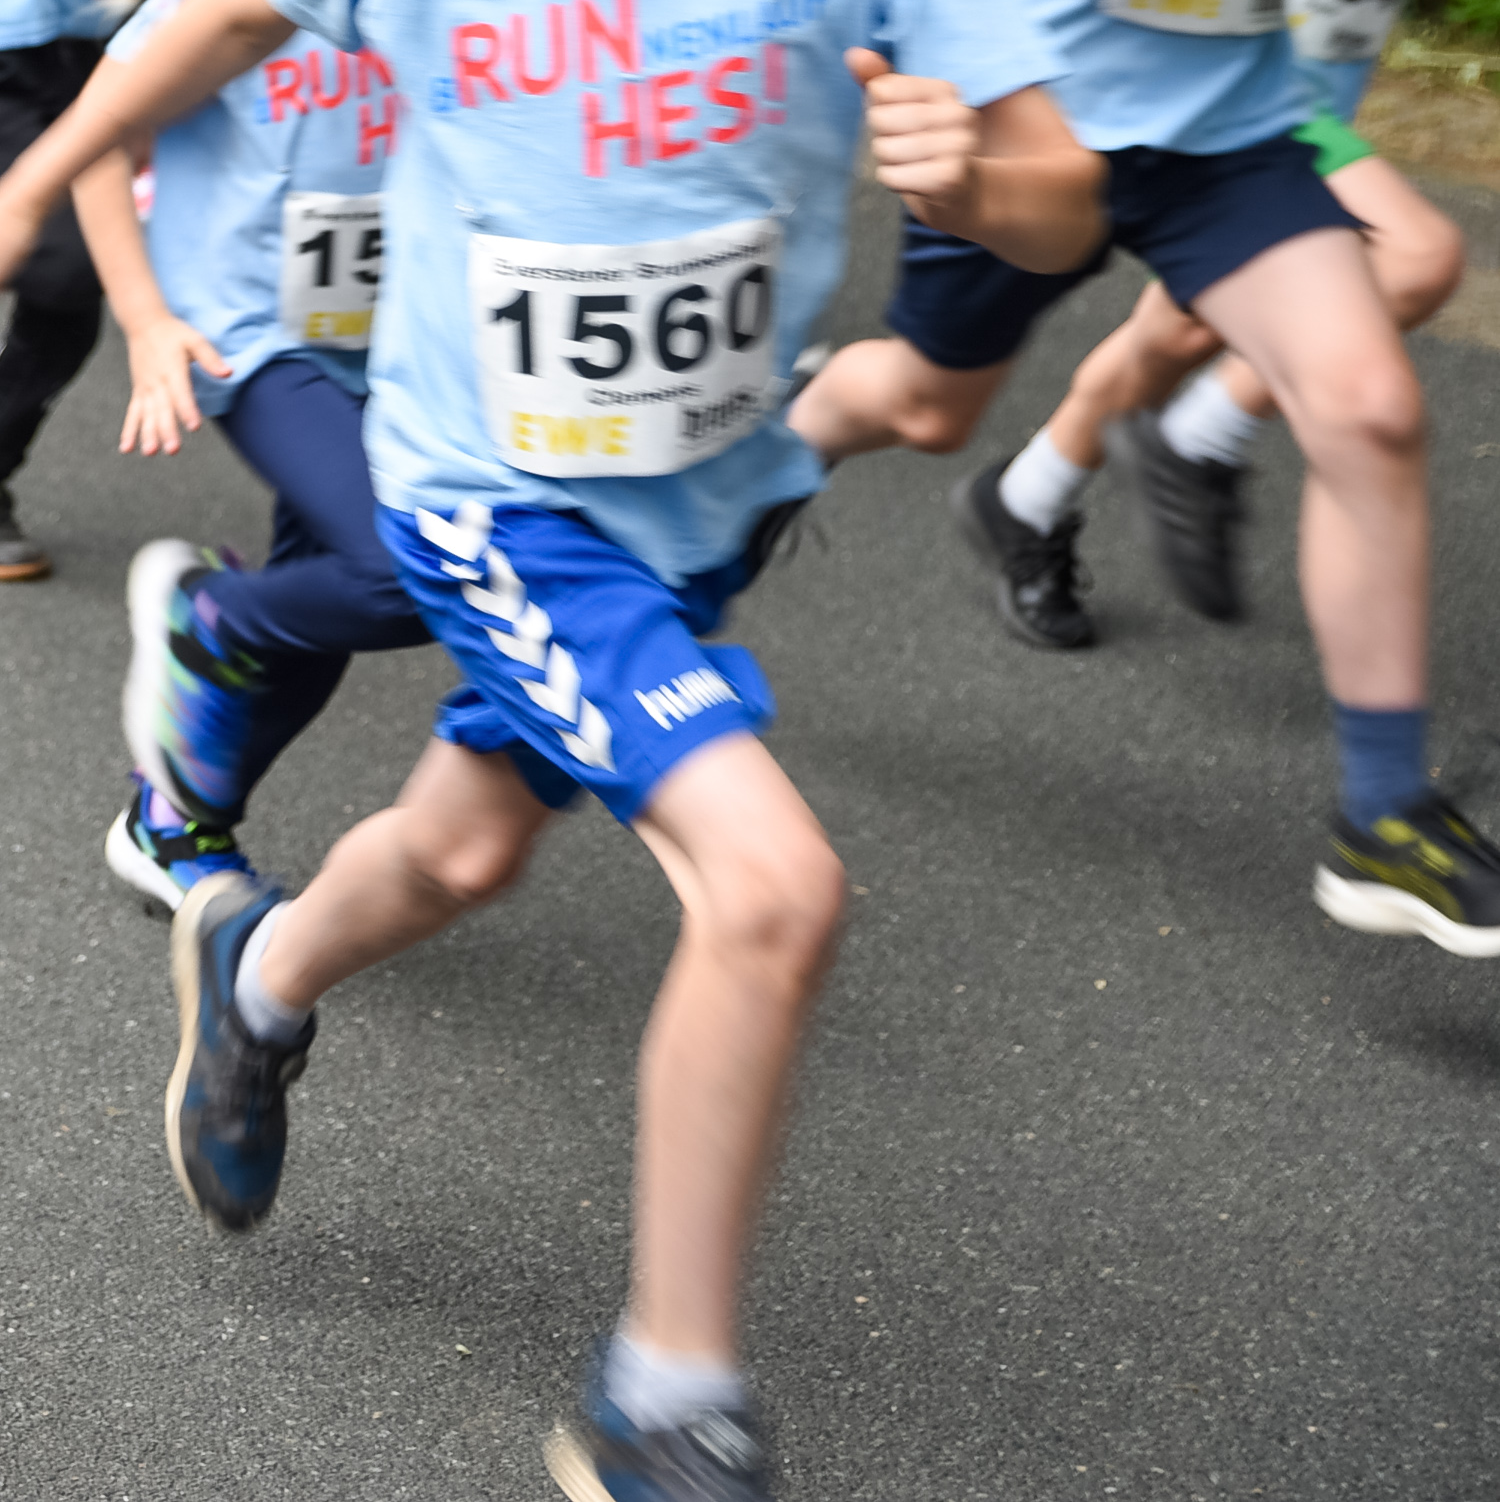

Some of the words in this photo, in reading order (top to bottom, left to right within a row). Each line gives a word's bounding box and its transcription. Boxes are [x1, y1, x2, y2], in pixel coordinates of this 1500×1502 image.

[264, 47, 396, 122] RUN
[581, 44, 787, 177] HES!
[489, 264, 773, 380] 1560
[511, 412, 634, 455] EWE
